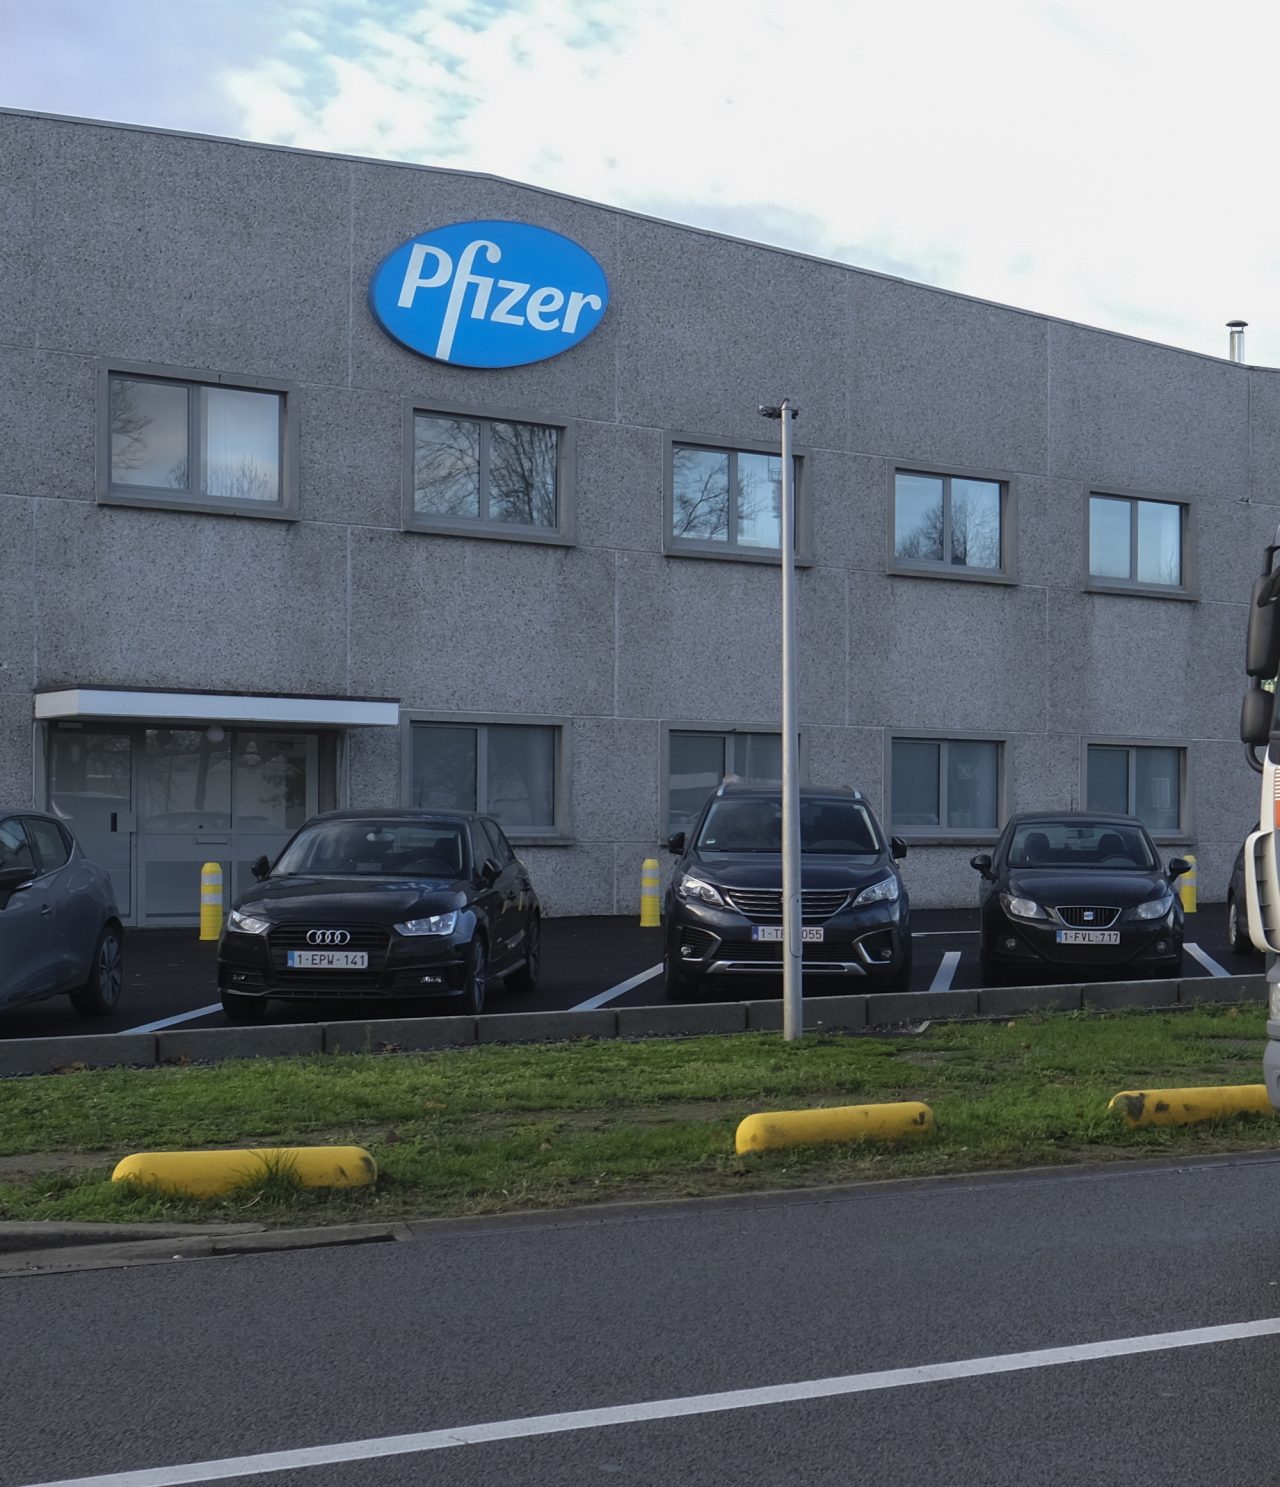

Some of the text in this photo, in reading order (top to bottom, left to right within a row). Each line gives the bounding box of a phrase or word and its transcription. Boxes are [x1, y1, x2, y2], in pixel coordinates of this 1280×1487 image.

[397, 239, 602, 361] Pfizer
[1063, 931, 1119, 943] 1-FVL-717
[297, 953, 365, 966] 1-EPW-141
